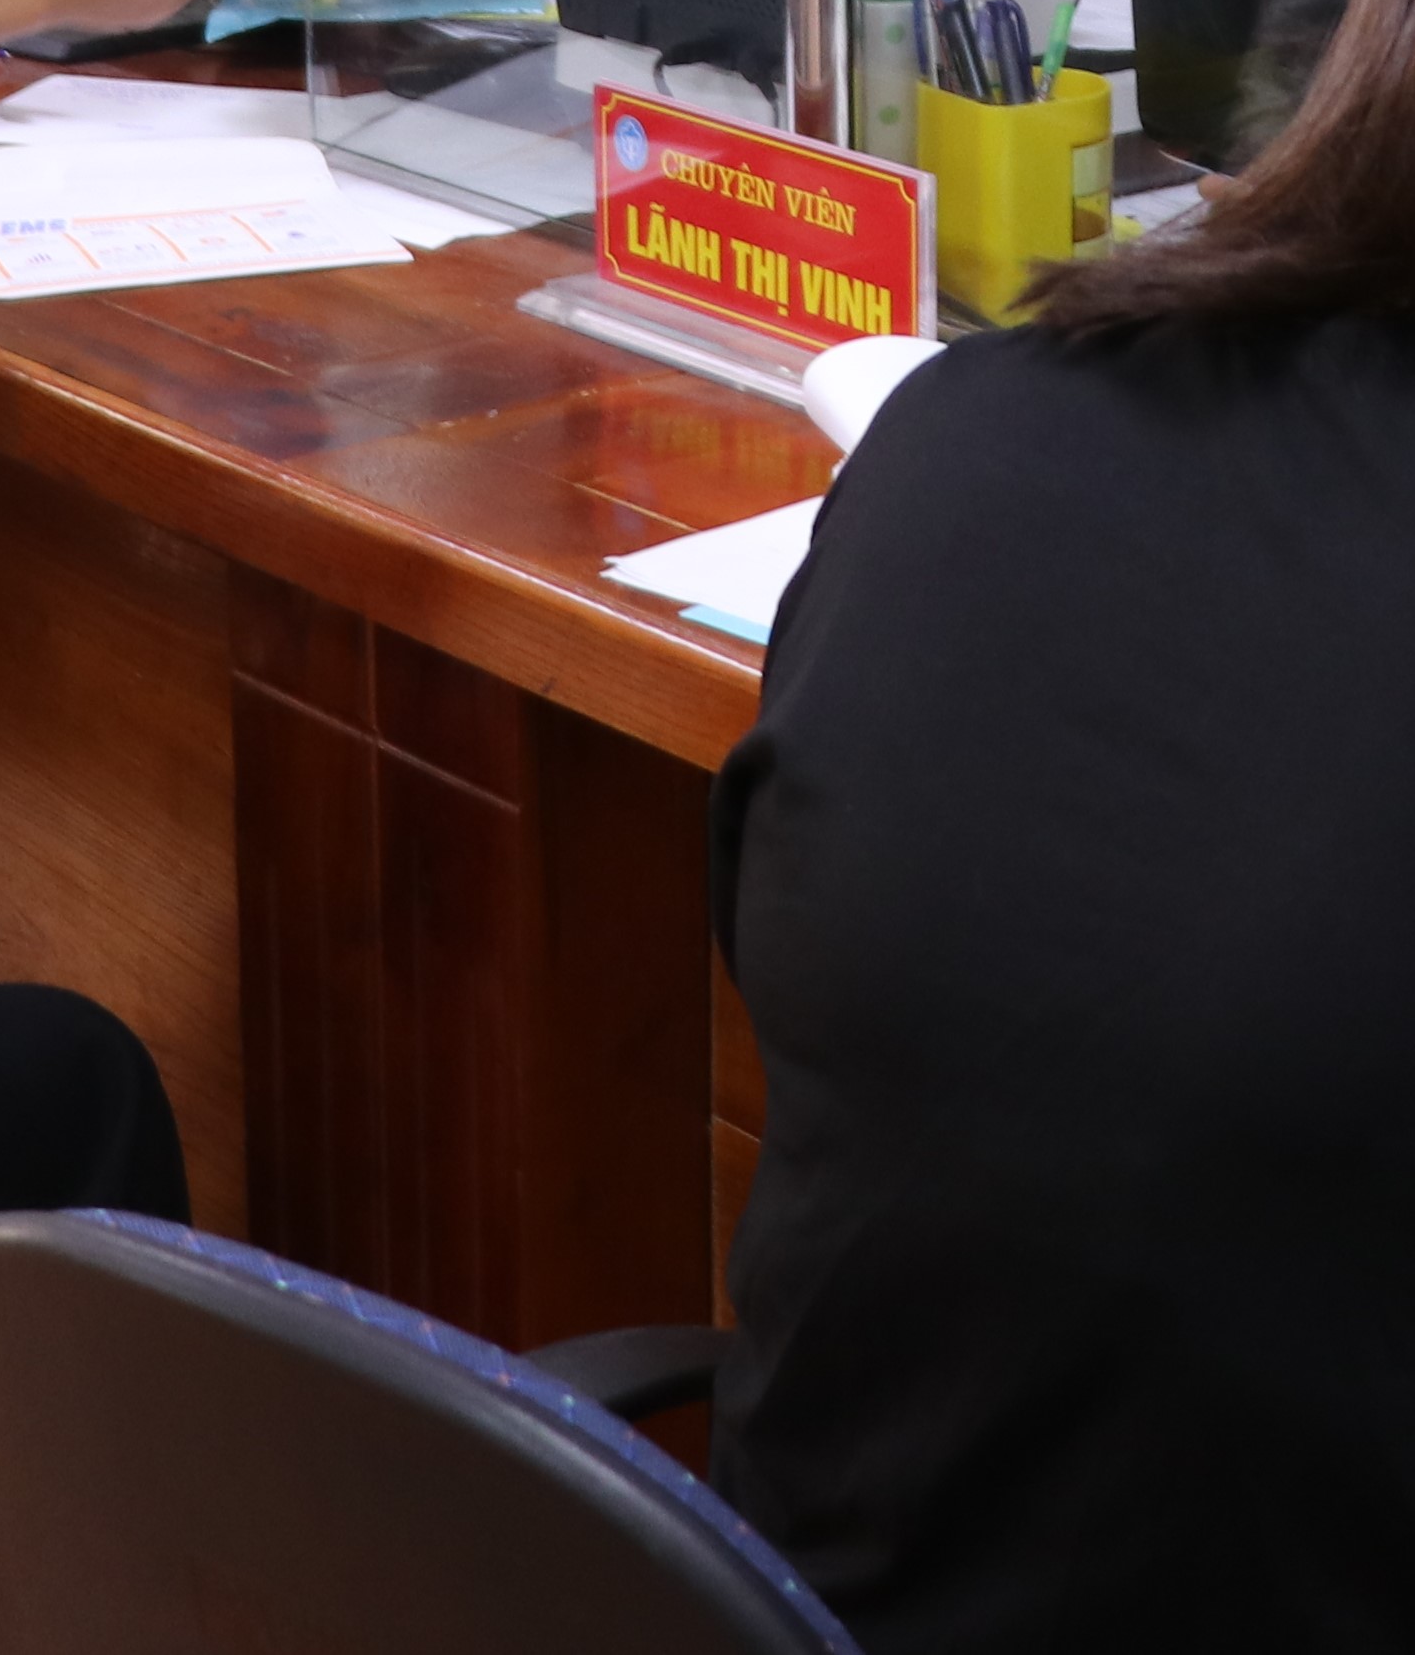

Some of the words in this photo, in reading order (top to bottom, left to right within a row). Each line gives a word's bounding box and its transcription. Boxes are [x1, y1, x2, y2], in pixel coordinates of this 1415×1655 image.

[660, 148, 776, 211] CHUYÊN
[783, 184, 857, 236] VIÊN
[627, 201, 721, 282] LÃNH
[731, 237, 789, 316] THỊ
[799, 261, 892, 337] VINH
